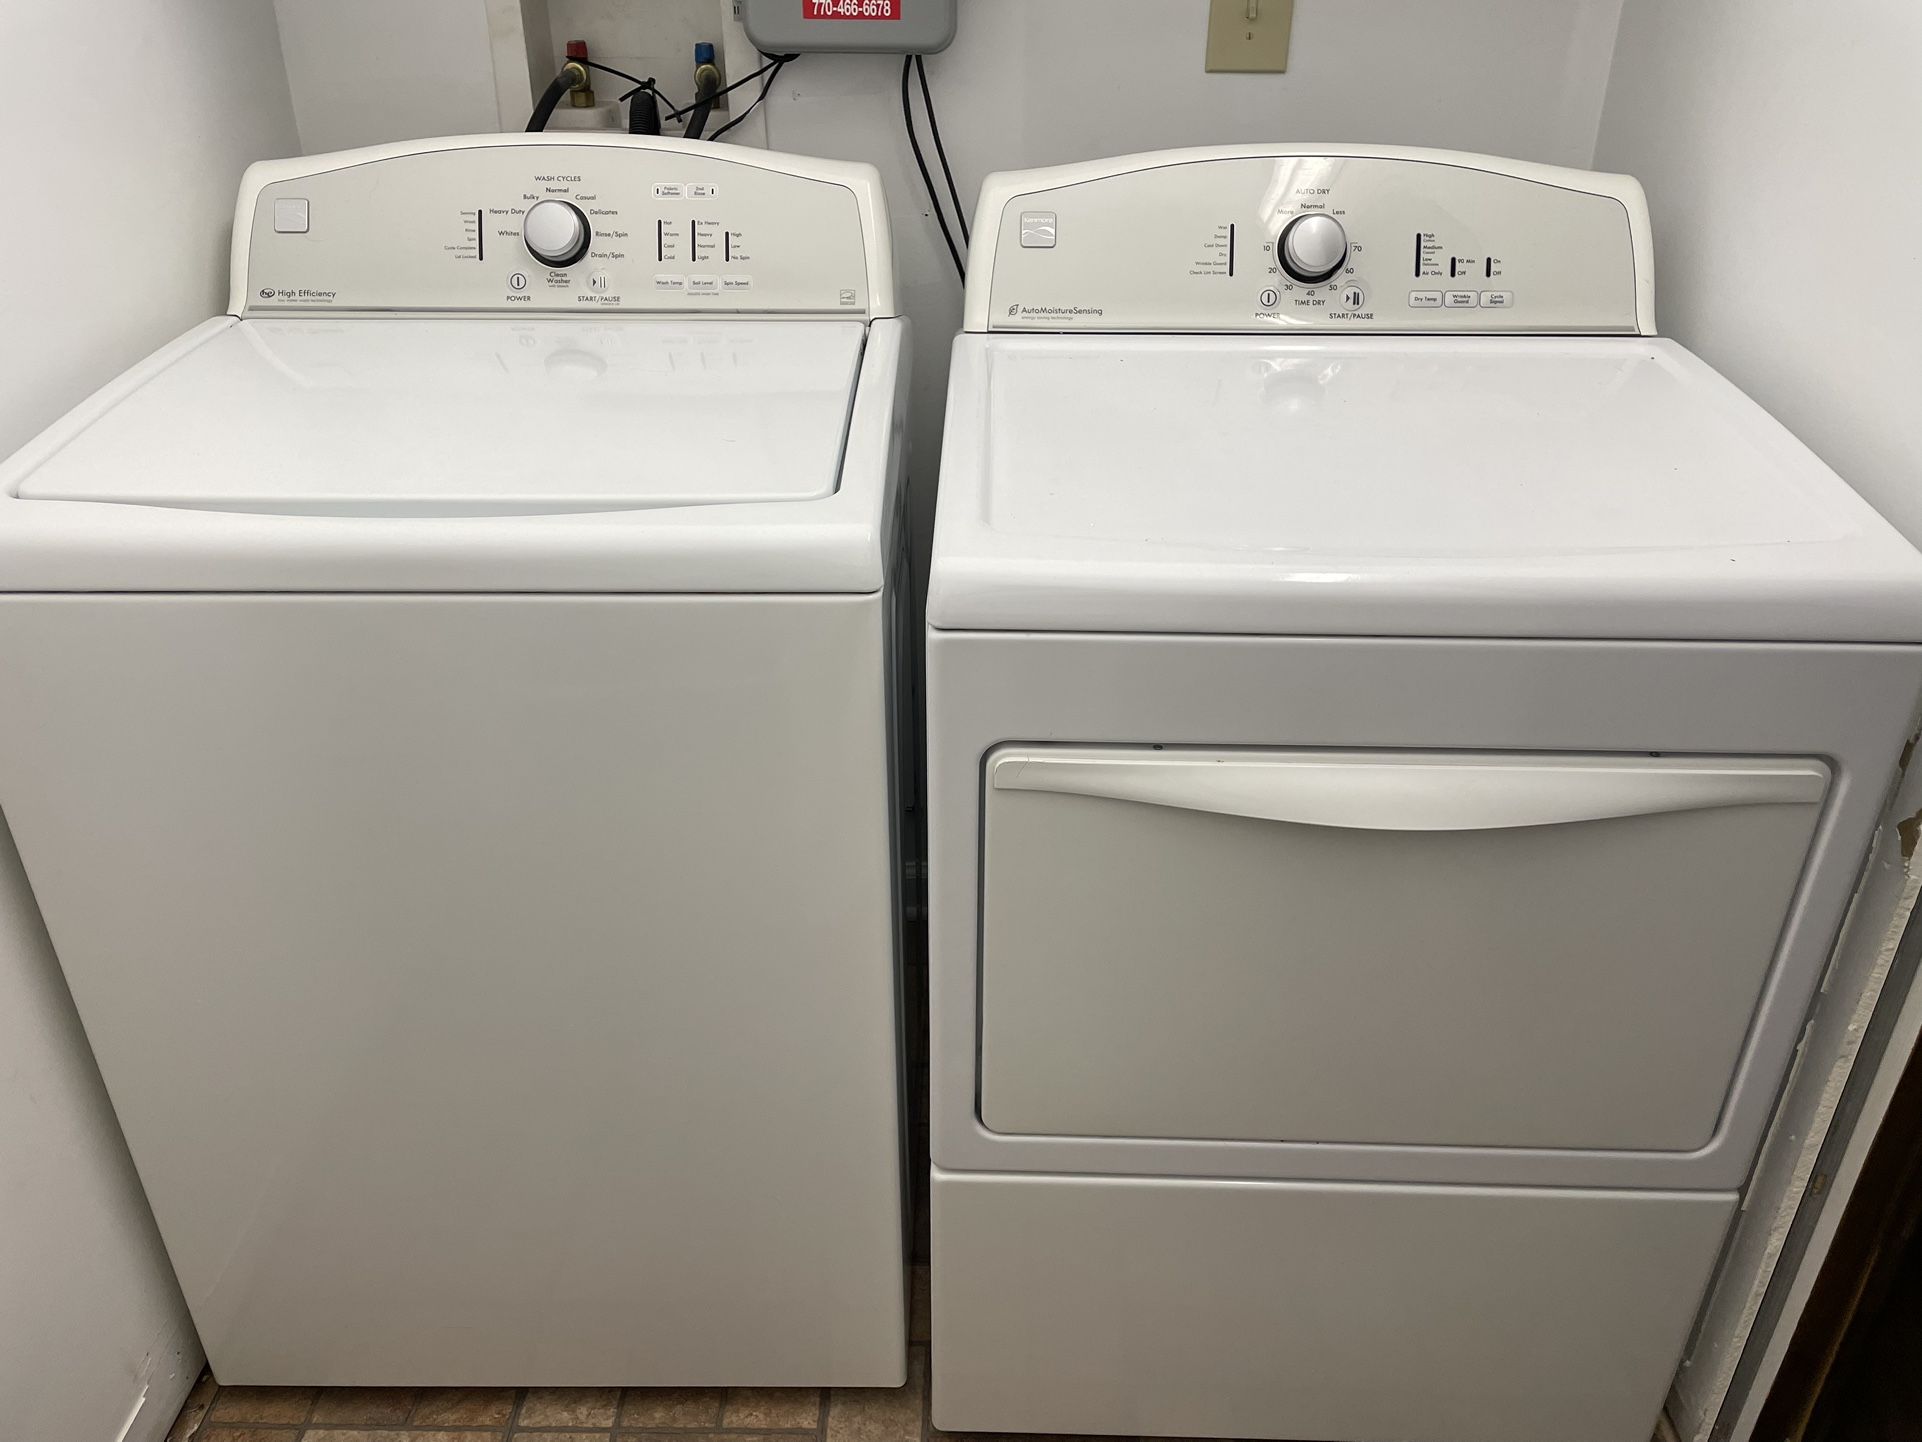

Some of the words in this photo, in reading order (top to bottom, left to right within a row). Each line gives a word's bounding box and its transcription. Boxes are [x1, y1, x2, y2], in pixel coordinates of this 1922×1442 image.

[812, 0, 891, 16] 770-466-6678
[299, 290, 336, 298] Efficiency
[1021, 307, 1102, 316] AutoMoistureSensing
